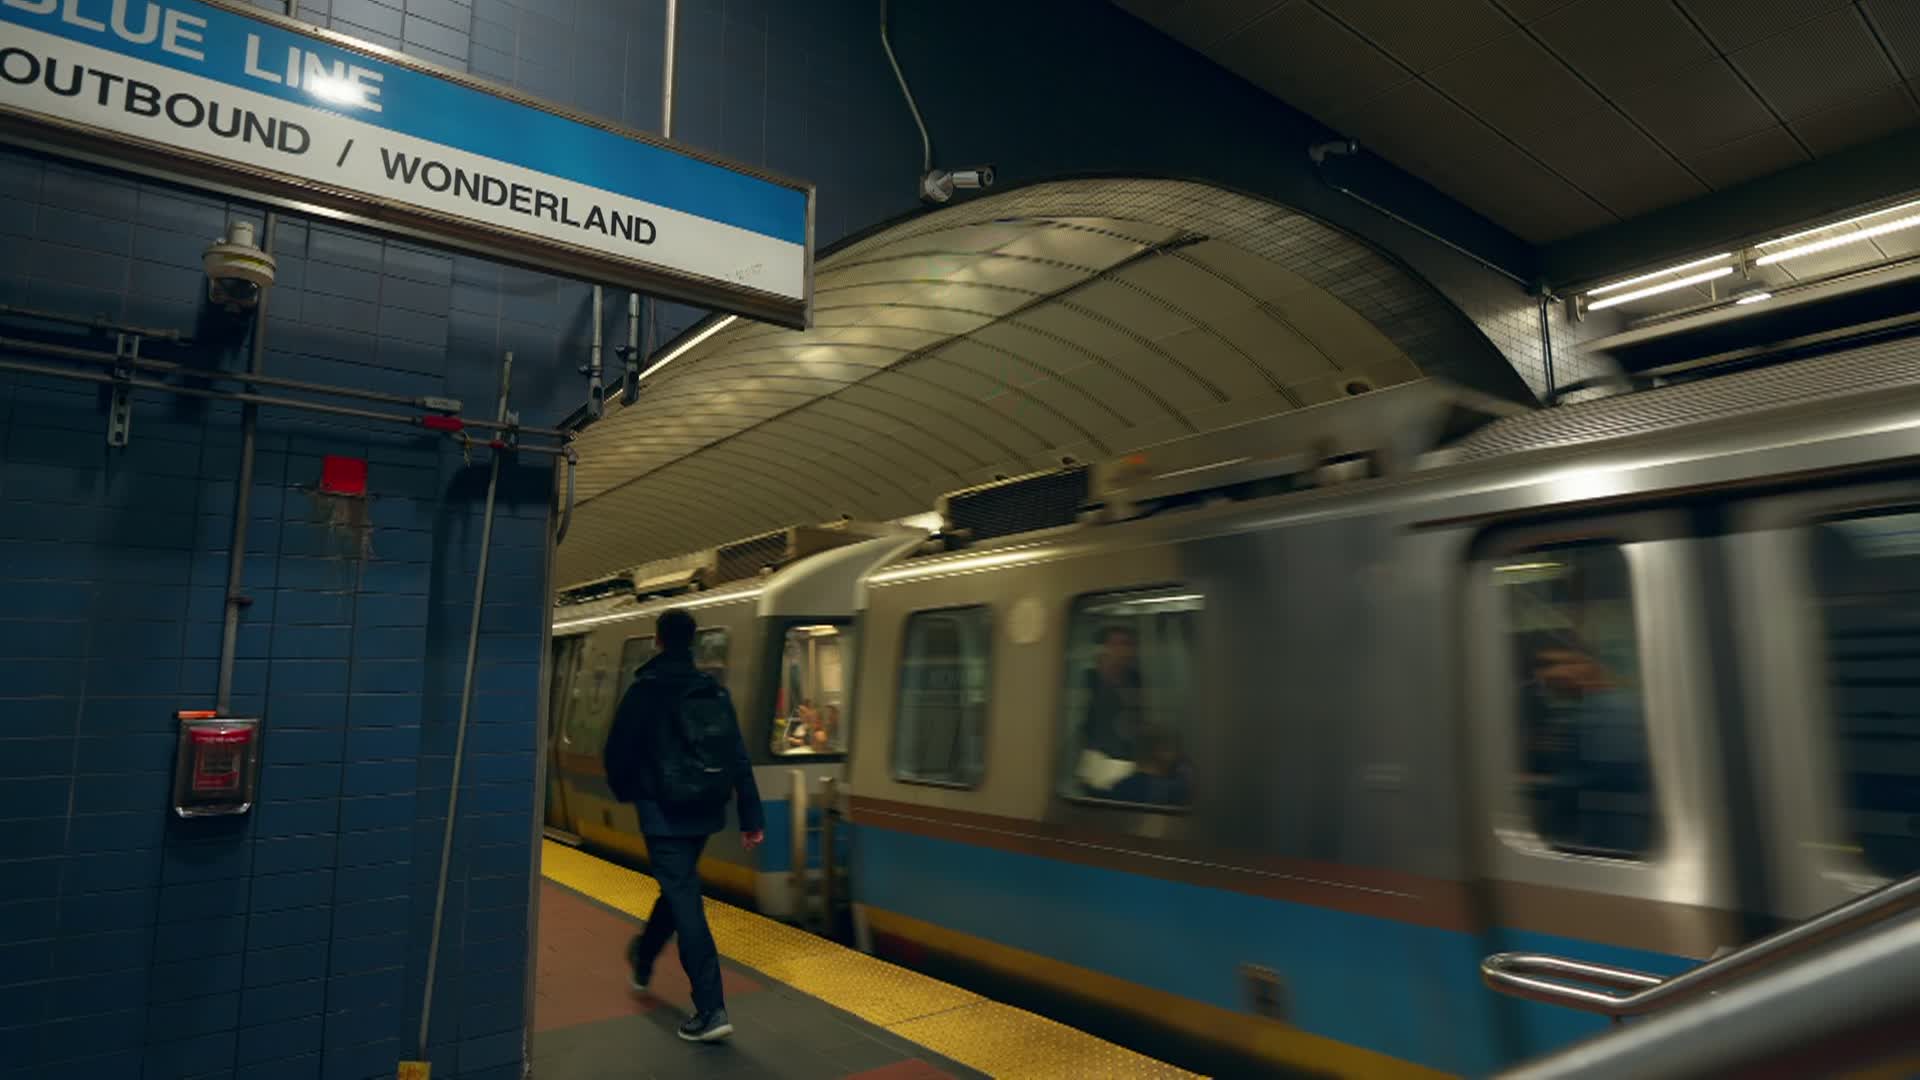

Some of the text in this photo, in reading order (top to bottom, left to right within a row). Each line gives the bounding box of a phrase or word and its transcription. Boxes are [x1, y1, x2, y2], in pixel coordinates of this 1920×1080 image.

[244, 33, 384, 112] LINE
[0, 47, 658, 246] OUTBOUND / WONDERLAND
